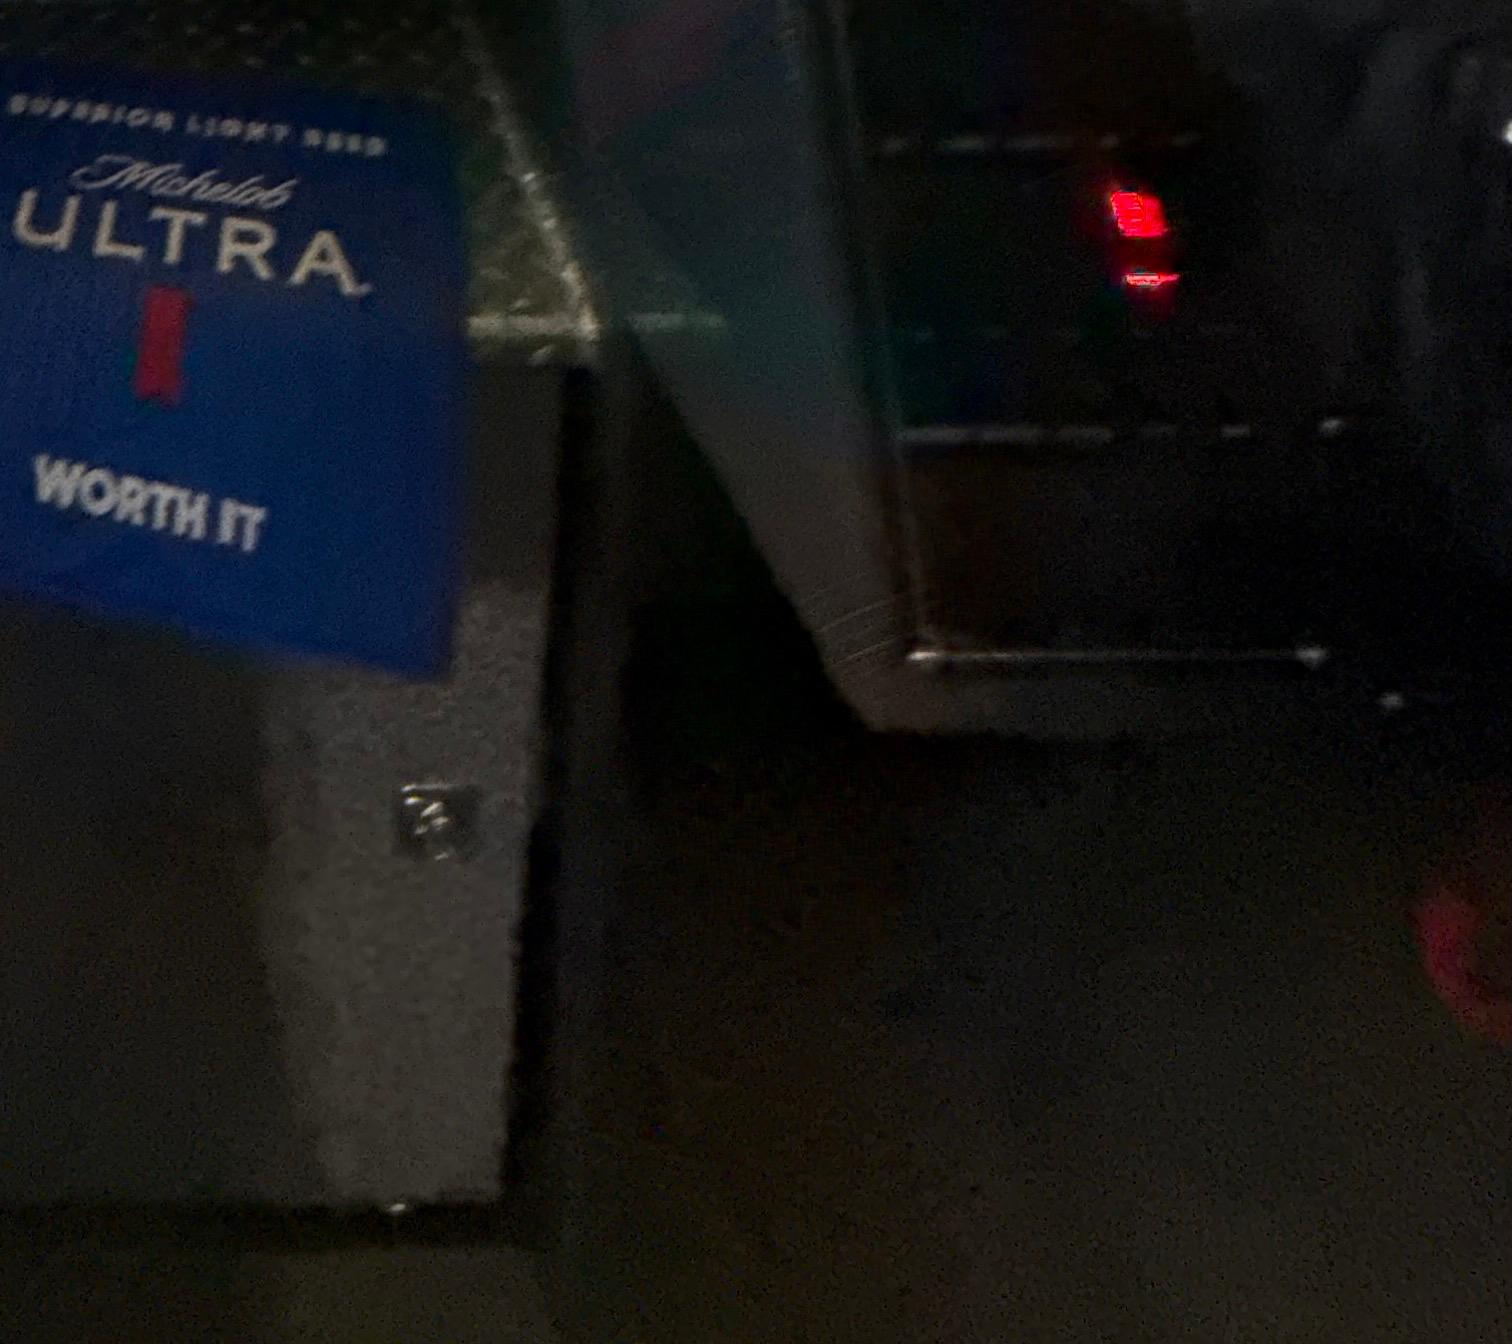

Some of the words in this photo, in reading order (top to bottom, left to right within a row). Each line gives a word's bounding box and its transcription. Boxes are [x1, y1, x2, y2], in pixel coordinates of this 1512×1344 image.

[70, 153, 299, 209] Michelob
[13, 186, 373, 297] ULTRA
[34, 454, 210, 540] WORTH
[217, 497, 267, 552] IT
